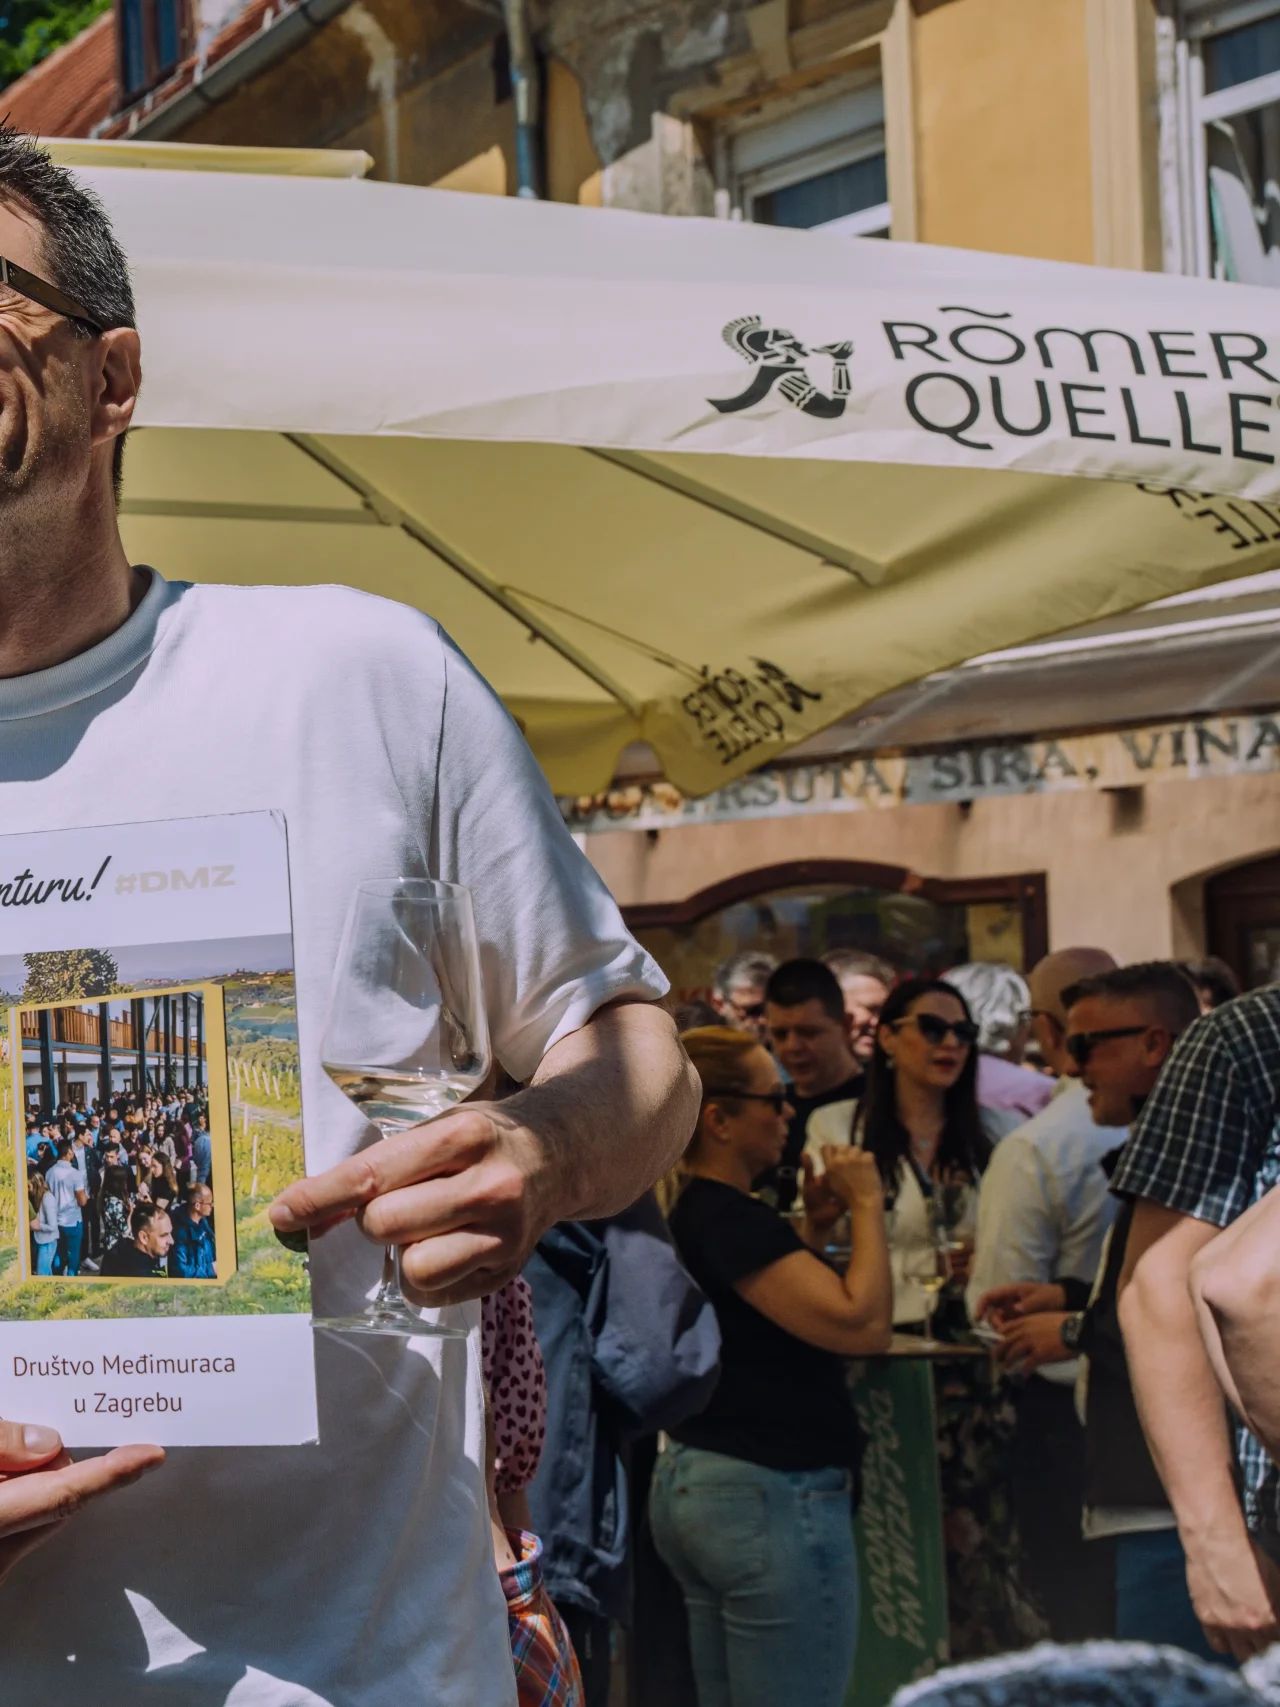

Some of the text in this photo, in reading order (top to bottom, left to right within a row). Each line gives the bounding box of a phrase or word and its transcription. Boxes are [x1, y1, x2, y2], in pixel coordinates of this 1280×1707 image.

[114, 863, 237, 897] #DMZ
[13, 1353, 236, 1377] Društvo Međimuraca
[73, 1391, 183, 1418] u Zagrebu
